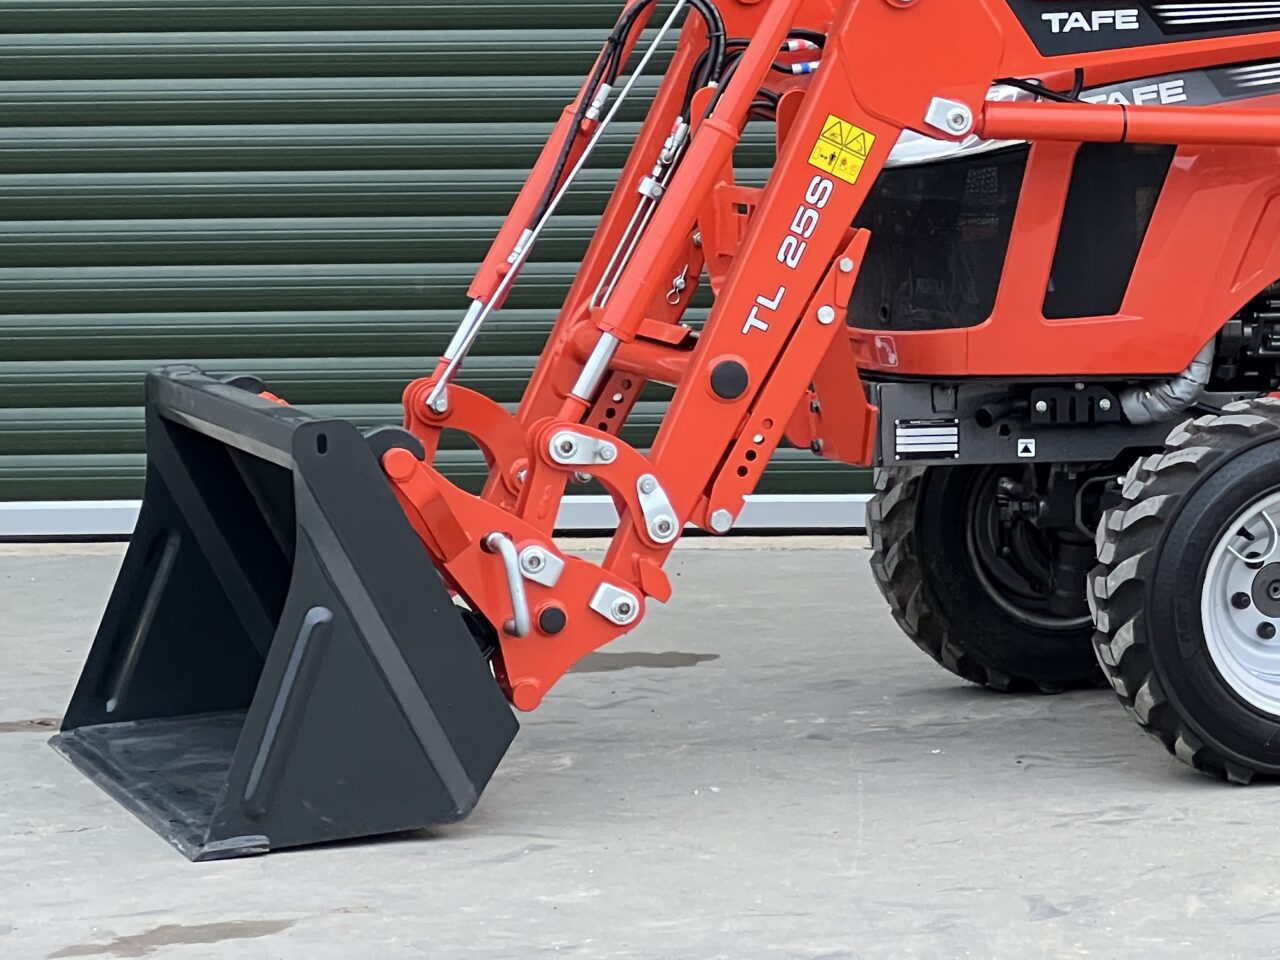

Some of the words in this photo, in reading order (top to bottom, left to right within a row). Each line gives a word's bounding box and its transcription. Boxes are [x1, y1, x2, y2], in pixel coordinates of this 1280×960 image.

[1041, 9, 1139, 33] TAFE
[741, 284, 786, 335] TL
[776, 175, 834, 270] 25S
